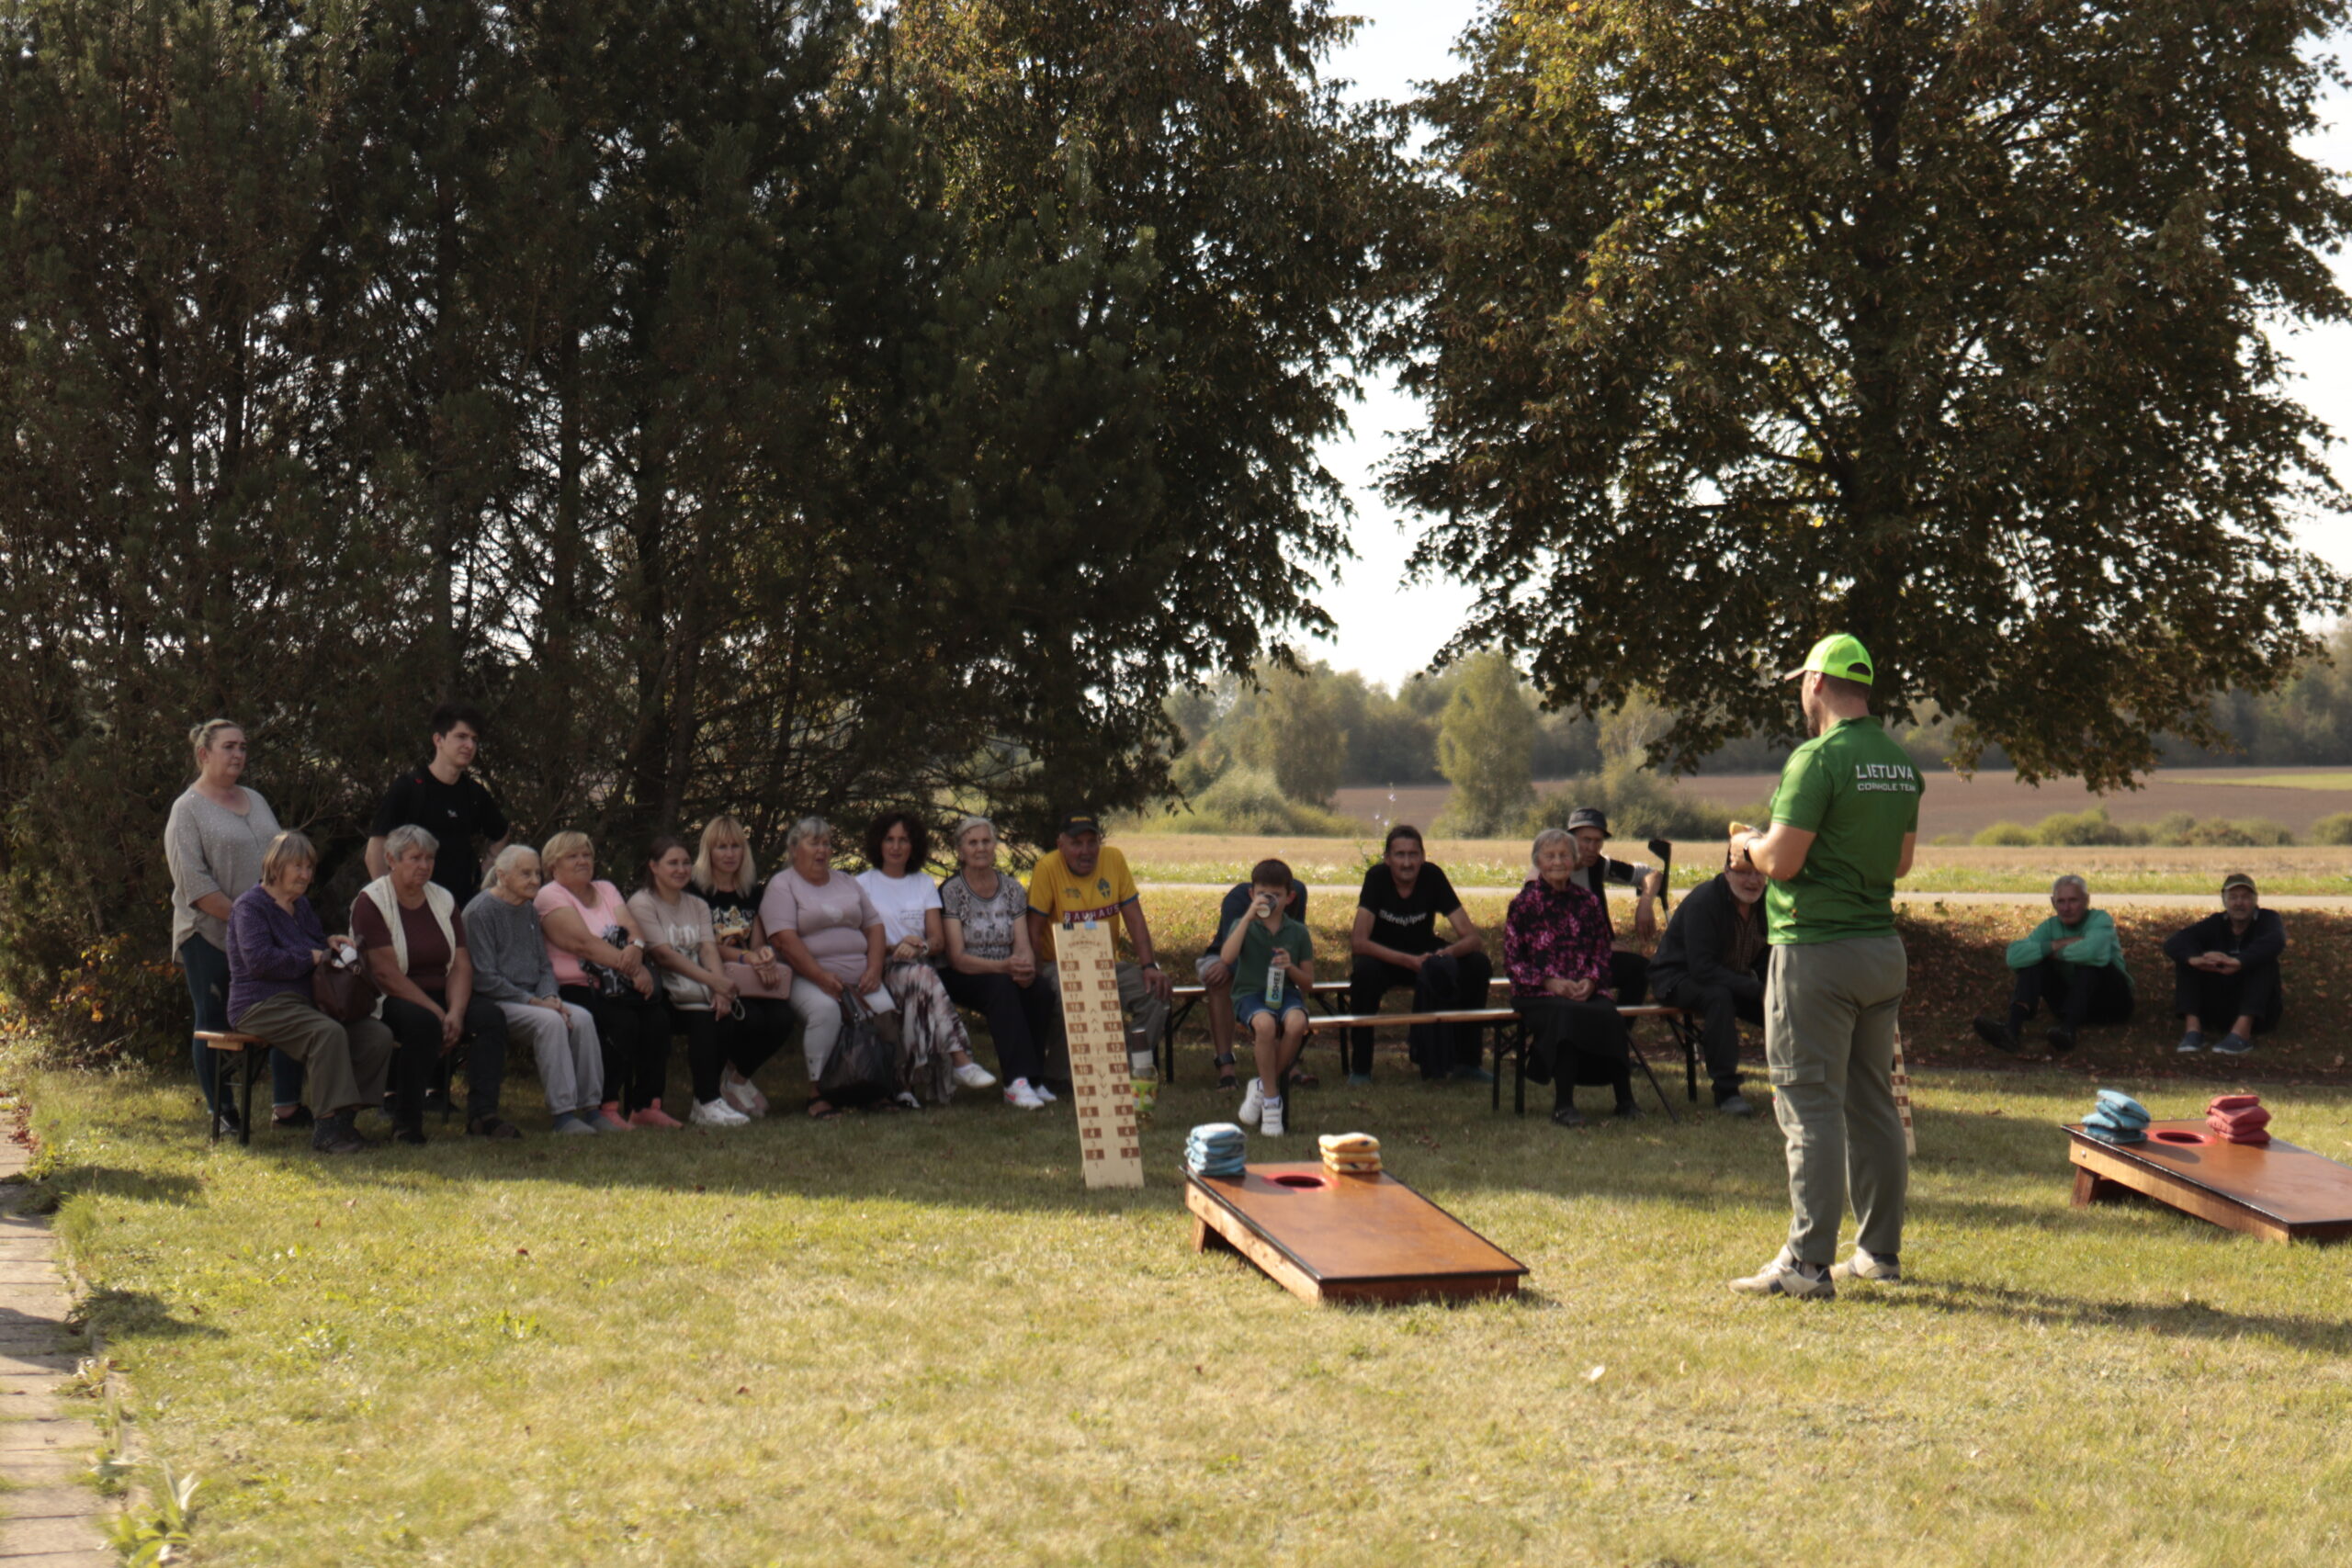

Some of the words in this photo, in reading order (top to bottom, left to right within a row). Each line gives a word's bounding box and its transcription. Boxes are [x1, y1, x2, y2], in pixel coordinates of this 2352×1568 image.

[1855, 764, 1915, 780] LIETUVA
[1857, 783, 1898, 792] CORNHOLE
[1068, 983, 1079, 991] 18
[1272, 972, 1281, 999] OSHEE
[1073, 1024, 1083, 1032] 14
[1076, 1045, 1086, 1054] 12
[1079, 1066, 1089, 1074] 10
[1114, 1065, 1124, 1073] 10
